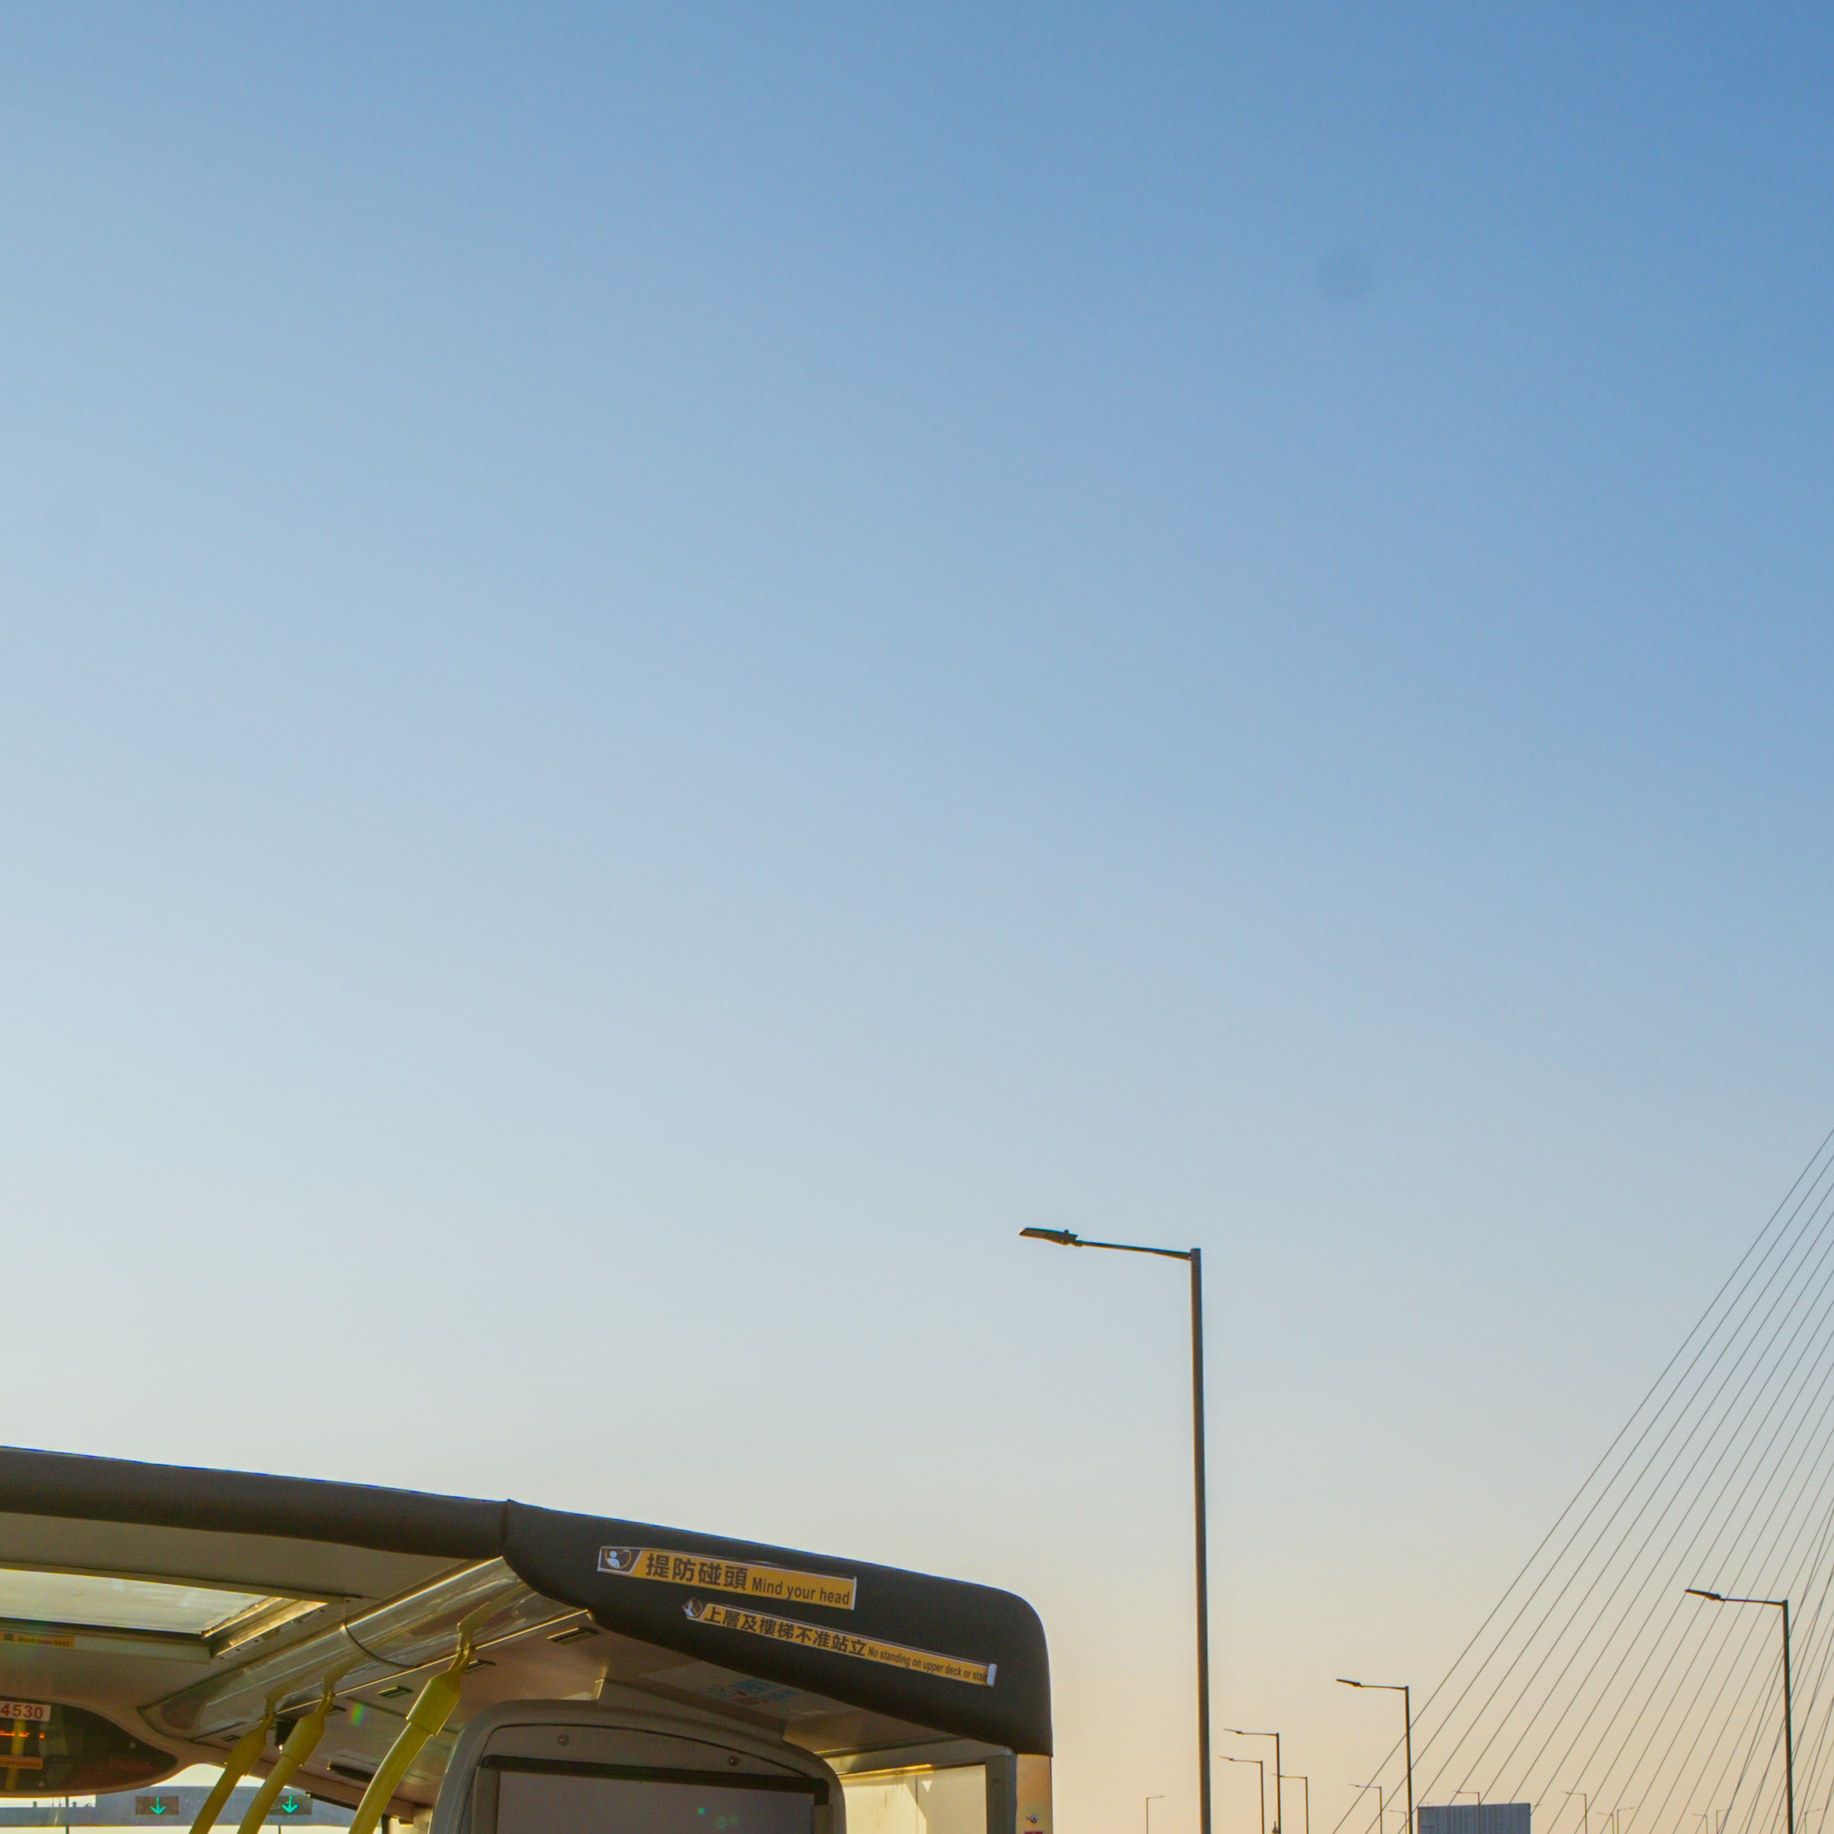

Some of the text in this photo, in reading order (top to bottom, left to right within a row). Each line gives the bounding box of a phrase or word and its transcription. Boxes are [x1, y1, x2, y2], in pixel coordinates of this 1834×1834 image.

[645, 1553, 850, 1605] 提防碰頭 Mind your head
[704, 1608, 866, 1657] 上層及樓梯不准站立
[868, 1646, 878, 1658] No
[880, 1648, 911, 1669] standing
[912, 1658, 921, 1668] on
[922, 1660, 944, 1674] upper
[944, 1664, 962, 1677] deck
[963, 1669, 971, 1678] or
